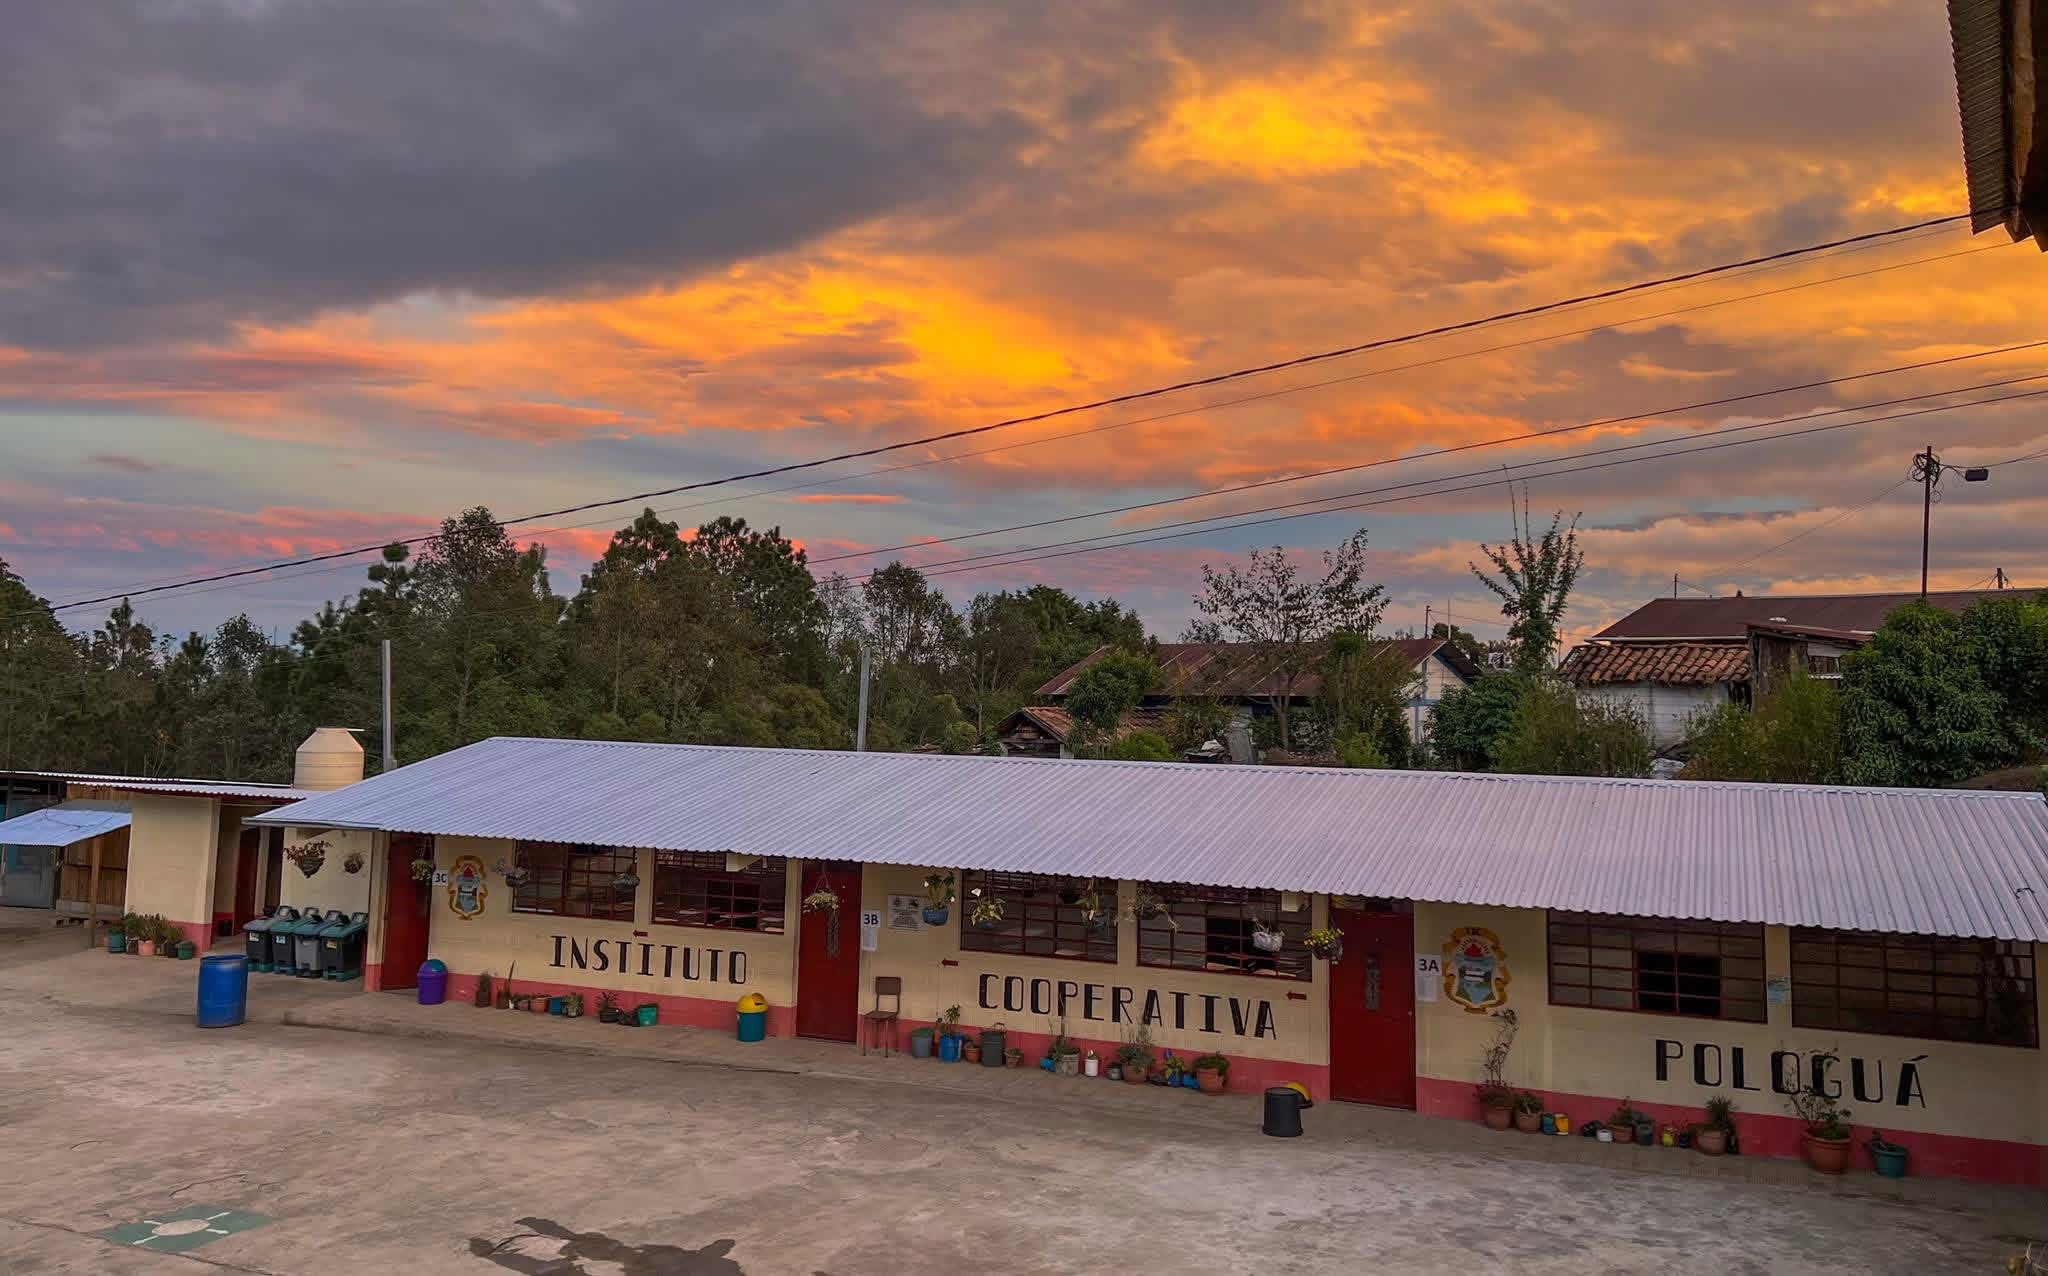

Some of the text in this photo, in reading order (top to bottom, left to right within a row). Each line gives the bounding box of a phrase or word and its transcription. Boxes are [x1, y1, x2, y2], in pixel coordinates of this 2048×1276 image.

[435, 873, 448, 883] 3C
[864, 914, 879, 925] 3B
[1419, 958, 1439, 972] 3A
[549, 935, 1929, 1109] INSTITUTO COOPERATIVA POLOGUÁ
